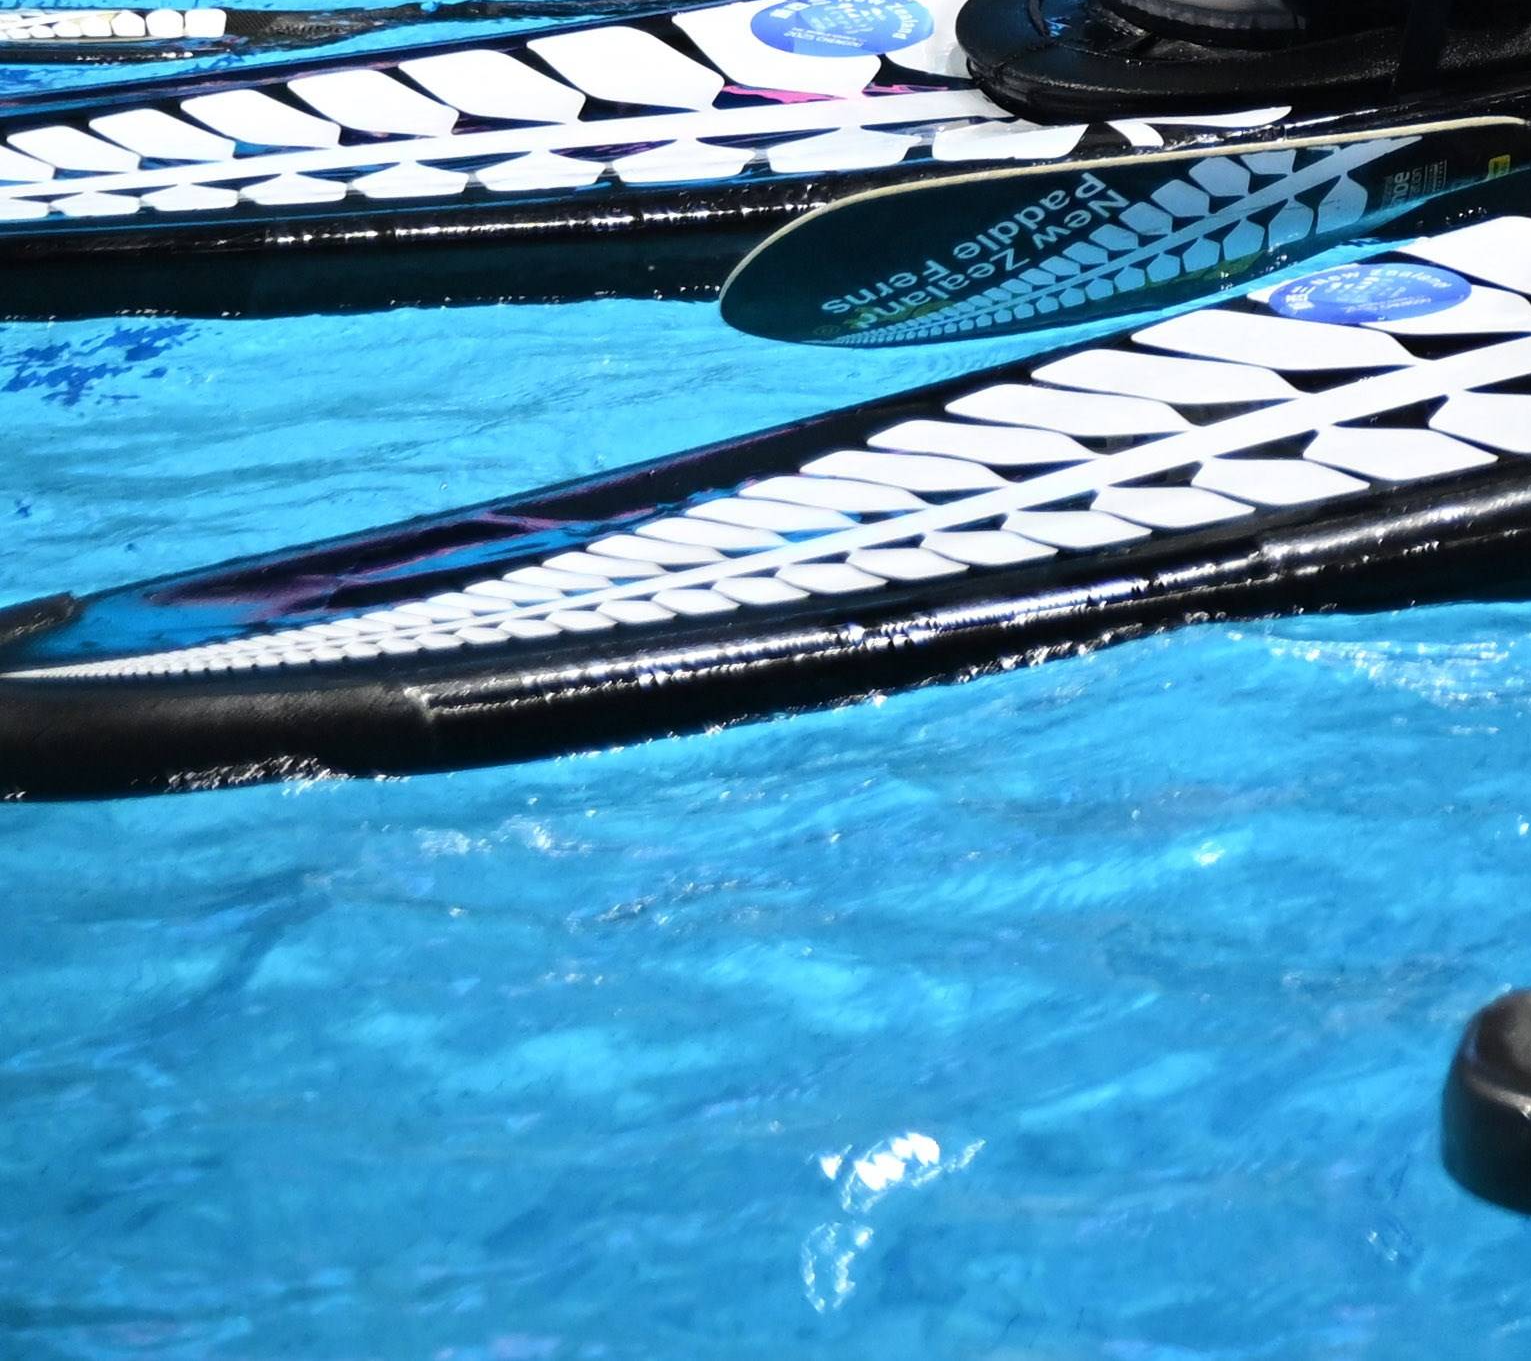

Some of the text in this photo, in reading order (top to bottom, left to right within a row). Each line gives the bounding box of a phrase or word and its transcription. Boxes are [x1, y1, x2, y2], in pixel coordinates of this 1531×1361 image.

[821, 171, 1107, 315] Paddle Ferns
[853, 188, 1130, 330] New Zealand
